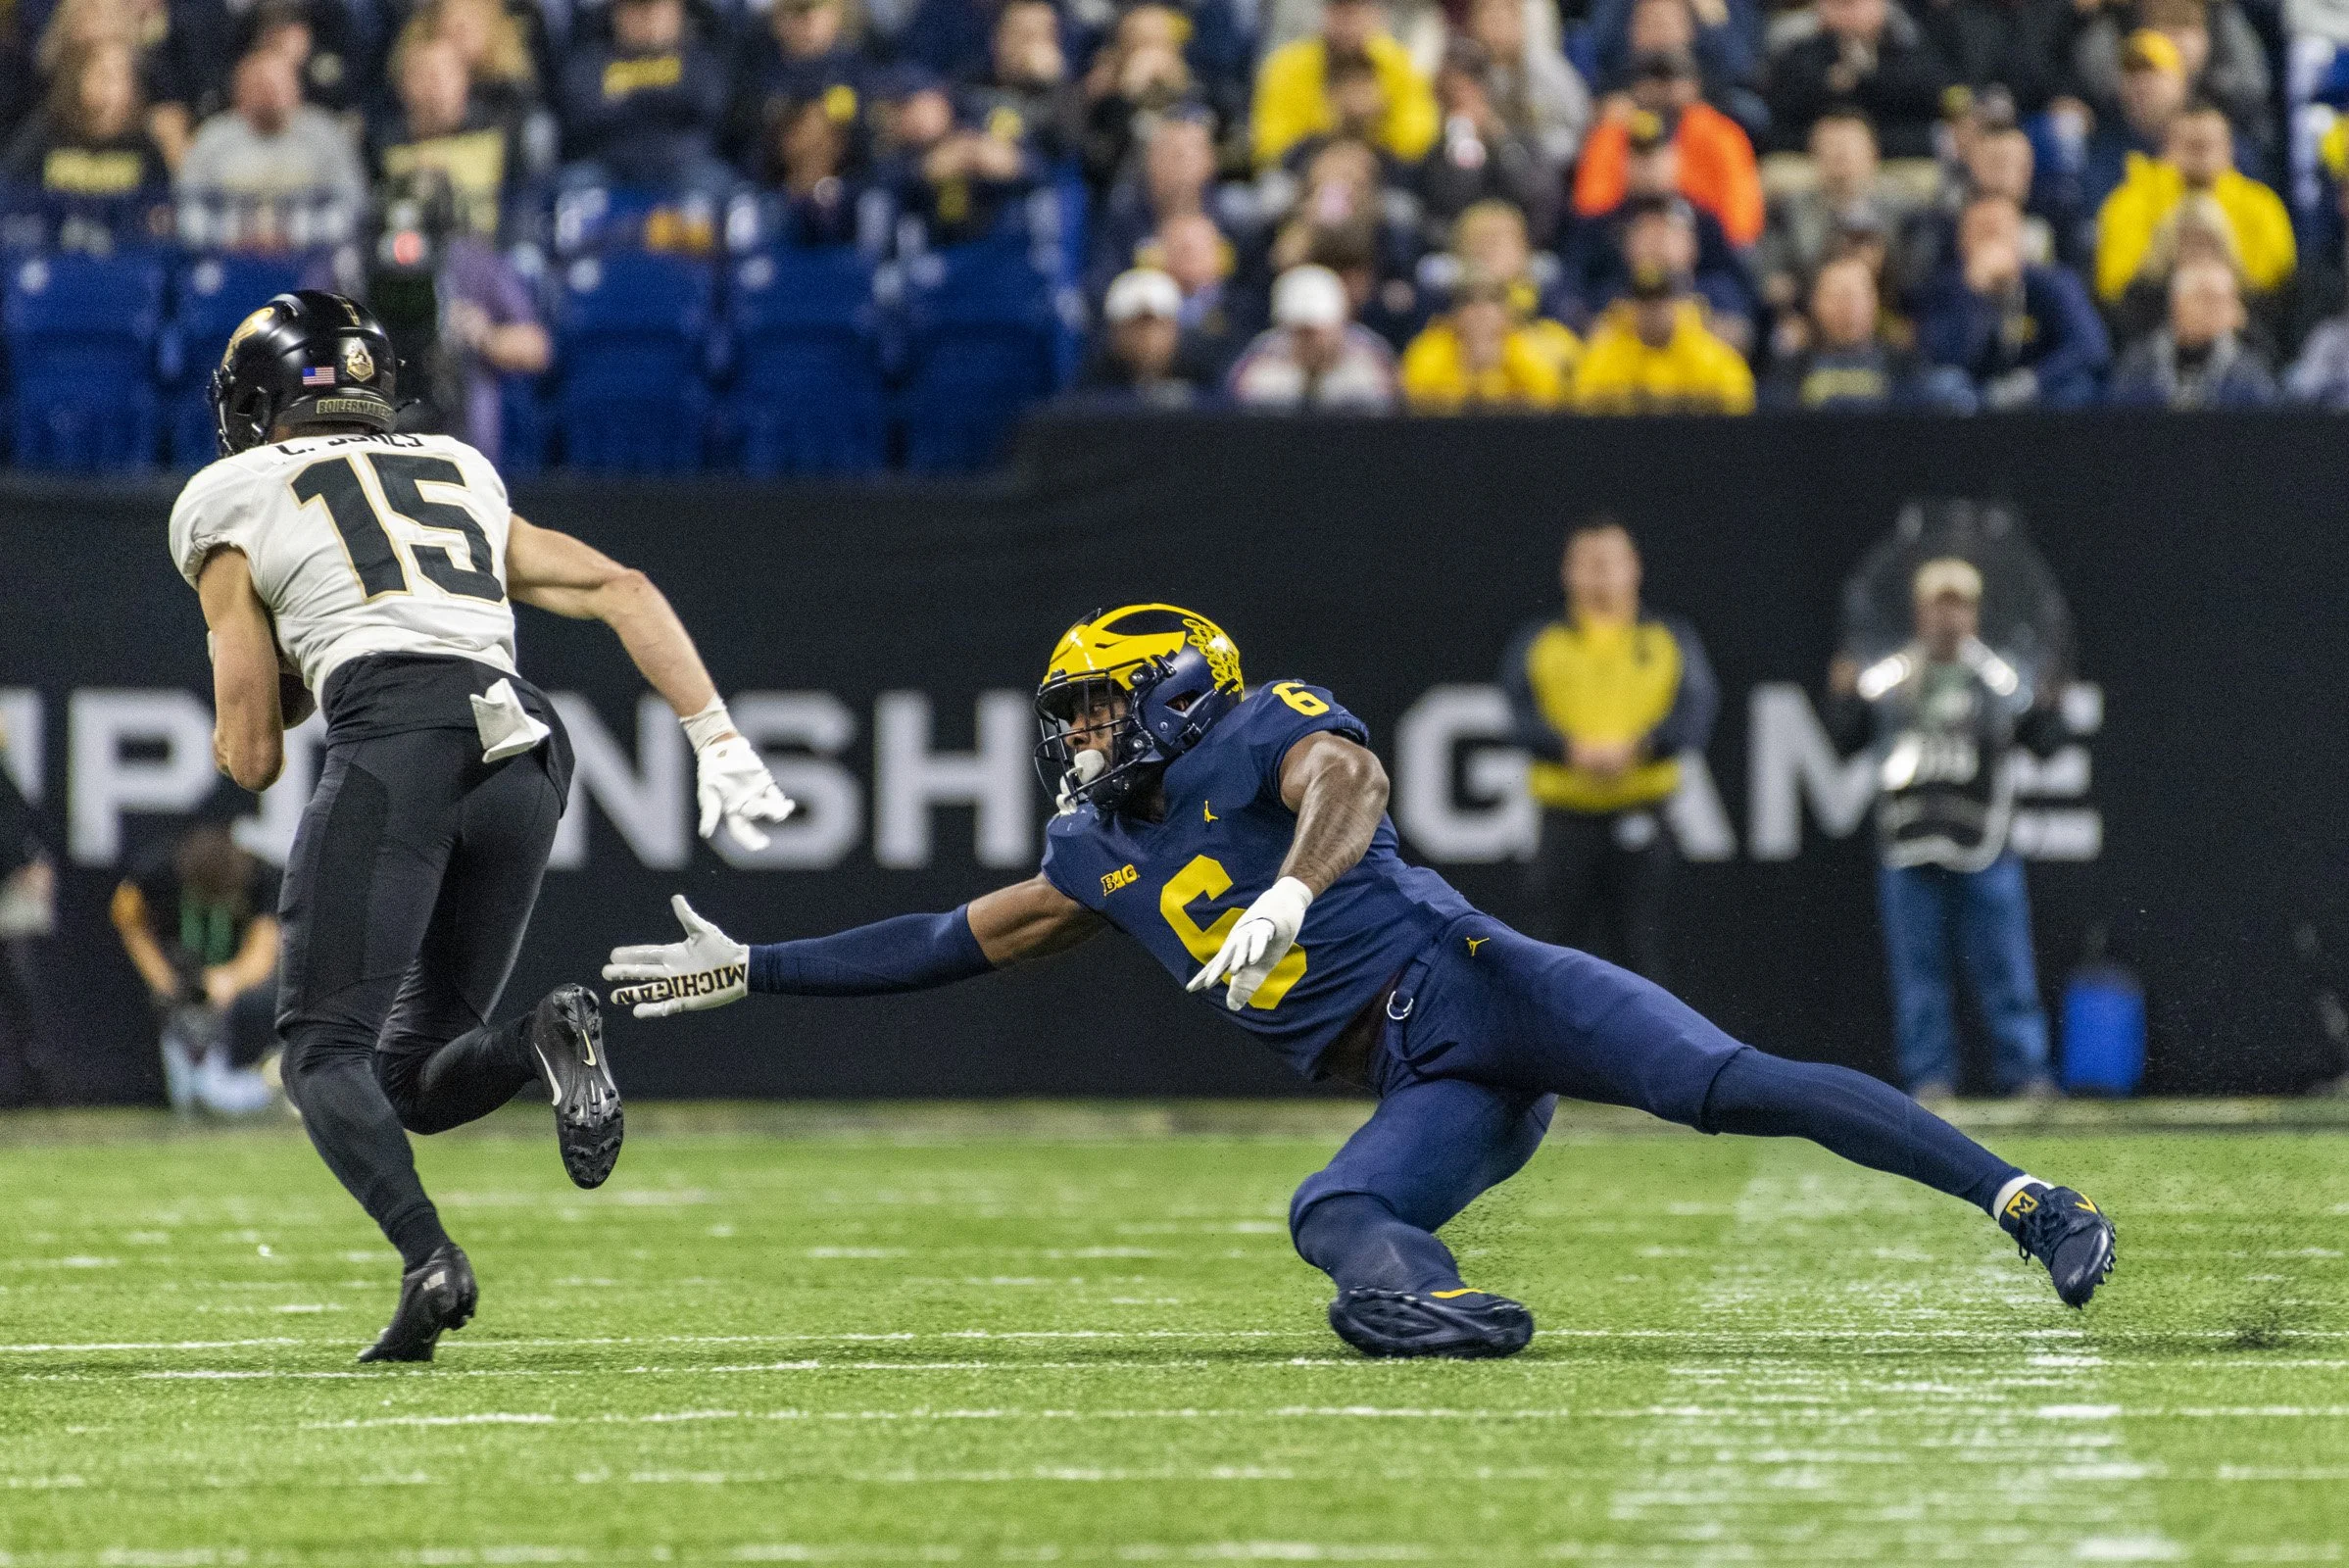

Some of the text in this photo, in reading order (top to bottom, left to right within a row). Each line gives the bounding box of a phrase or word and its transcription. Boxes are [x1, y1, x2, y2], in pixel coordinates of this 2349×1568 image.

[289, 452, 507, 607] 15
[1272, 682, 1330, 716] 6
[1159, 855, 1307, 1010] 6
[615, 962, 747, 1005] MICHIGAN
[2009, 1193, 2035, 1217] M
